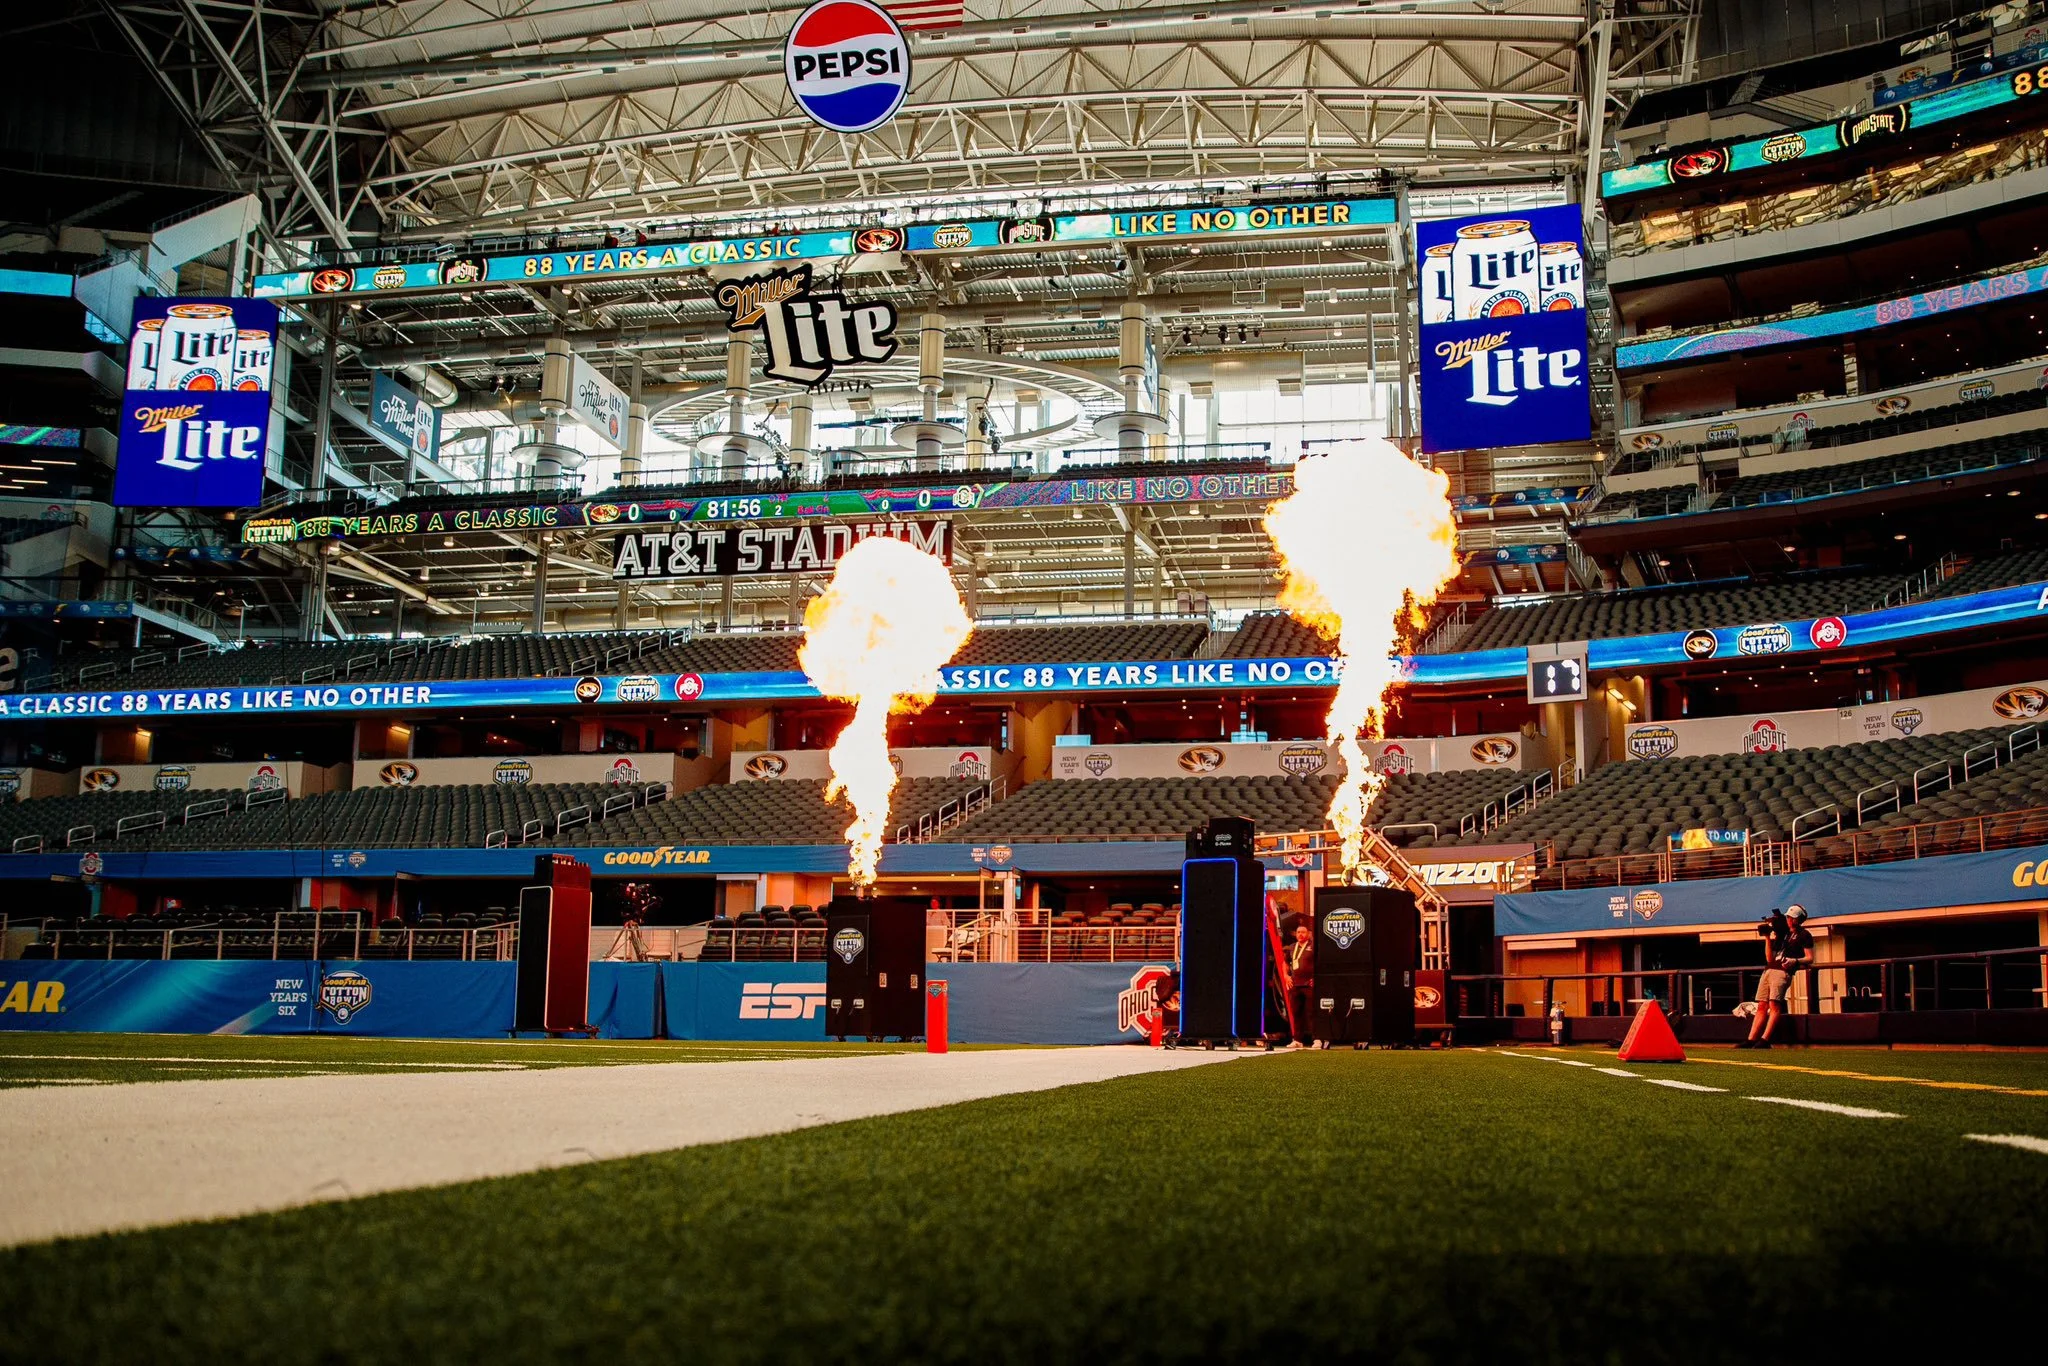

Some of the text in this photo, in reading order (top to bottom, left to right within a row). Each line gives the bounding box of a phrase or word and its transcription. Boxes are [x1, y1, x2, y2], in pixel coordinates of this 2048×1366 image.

[793, 47, 901, 82] PEPSI
[1764, 141, 1804, 158] COTTON
[1114, 203, 1350, 235] LIKE NO OTHER
[524, 238, 801, 277] 88 YEARS A CLASSIC
[1468, 248, 1535, 290] Lite
[1541, 262, 1581, 291] ite
[719, 273, 805, 327] Miller
[1876, 297, 1914, 324] 88
[1924, 271, 2030, 312] YEARS
[172, 328, 233, 365] Lite
[755, 300, 892, 382] Lite
[1435, 331, 1511, 370] Miller
[234, 350, 270, 373] ite
[1466, 346, 1581, 406] Lite
[579, 385, 608, 407] Miller
[588, 380, 600, 394] IT'S
[381, 400, 415, 423] Miller
[391, 395, 407, 409] IT'S
[608, 392, 622, 413] Lite
[135, 404, 203, 433] Miller
[417, 407, 432, 428] Lite
[591, 405, 606, 424] TIME
[395, 421, 414, 439] TIME
[156, 418, 260, 470] Lite
[1071, 475, 1296, 501] LIKE NO OTHER
[707, 498, 762, 518] 81:56
[882, 499, 889, 510] 0
[919, 489, 931, 508] 0
[627, 503, 640, 521] 0
[669, 509, 677, 521] 0
[774, 505, 782, 516] 2
[303, 507, 558, 537] 88 YEARS A CLASSIC
[246, 525, 294, 542] COTTON
[613, 520, 949, 577] AT&T STADM
[1741, 634, 1787, 651] COTTON
[935, 667, 1011, 690] ASSIC
[1022, 667, 1055, 688] 88
[1066, 665, 1158, 686] YEARS
[1172, 663, 1234, 685] LIKE
[1248, 661, 1291, 683] NO
[1547, 659, 1580, 694] 17
[19, 695, 112, 715] CLASSIC
[121, 694, 149, 713] 88
[158, 693, 232, 711] YEARS
[242, 690, 293, 709] LIKE
[303, 688, 340, 707] NO
[350, 686, 431, 706] OTHER
[1839, 710, 1852, 718] 126
[1865, 715, 1882, 723] NEW
[1632, 730, 1673, 738] GOODYEAR
[1863, 722, 1886, 730] YEAR'S
[1632, 737, 1675, 753] COTTON
[1640, 744, 1671, 755] BOWL
[1743, 728, 1787, 754] OHIO STATE
[966, 759, 988, 776] STATE
[1282, 755, 1323, 769] COTTON
[1289, 762, 1316, 771] BOWL
[1391, 754, 1414, 773] STATE
[495, 769, 530, 782] COTTON
[603, 846, 711, 868] GOODYEAR
[1608, 903, 1629, 911] YEAR'S
[1610, 896, 1626, 904] NEW
[1327, 913, 1361, 921] GOODYEAR
[1327, 920, 1361, 933] COTTON
[275, 979, 303, 989] NEW
[324, 978, 367, 987] GOODYEAR
[270, 992, 308, 1003] YEAR'S
[322, 986, 368, 1001] COTTON
[330, 996, 358, 1007] BOWL
[739, 982, 827, 1019] ESP
[277, 1005, 298, 1016] SIX
[1120, 990, 1149, 1029] OHIO
